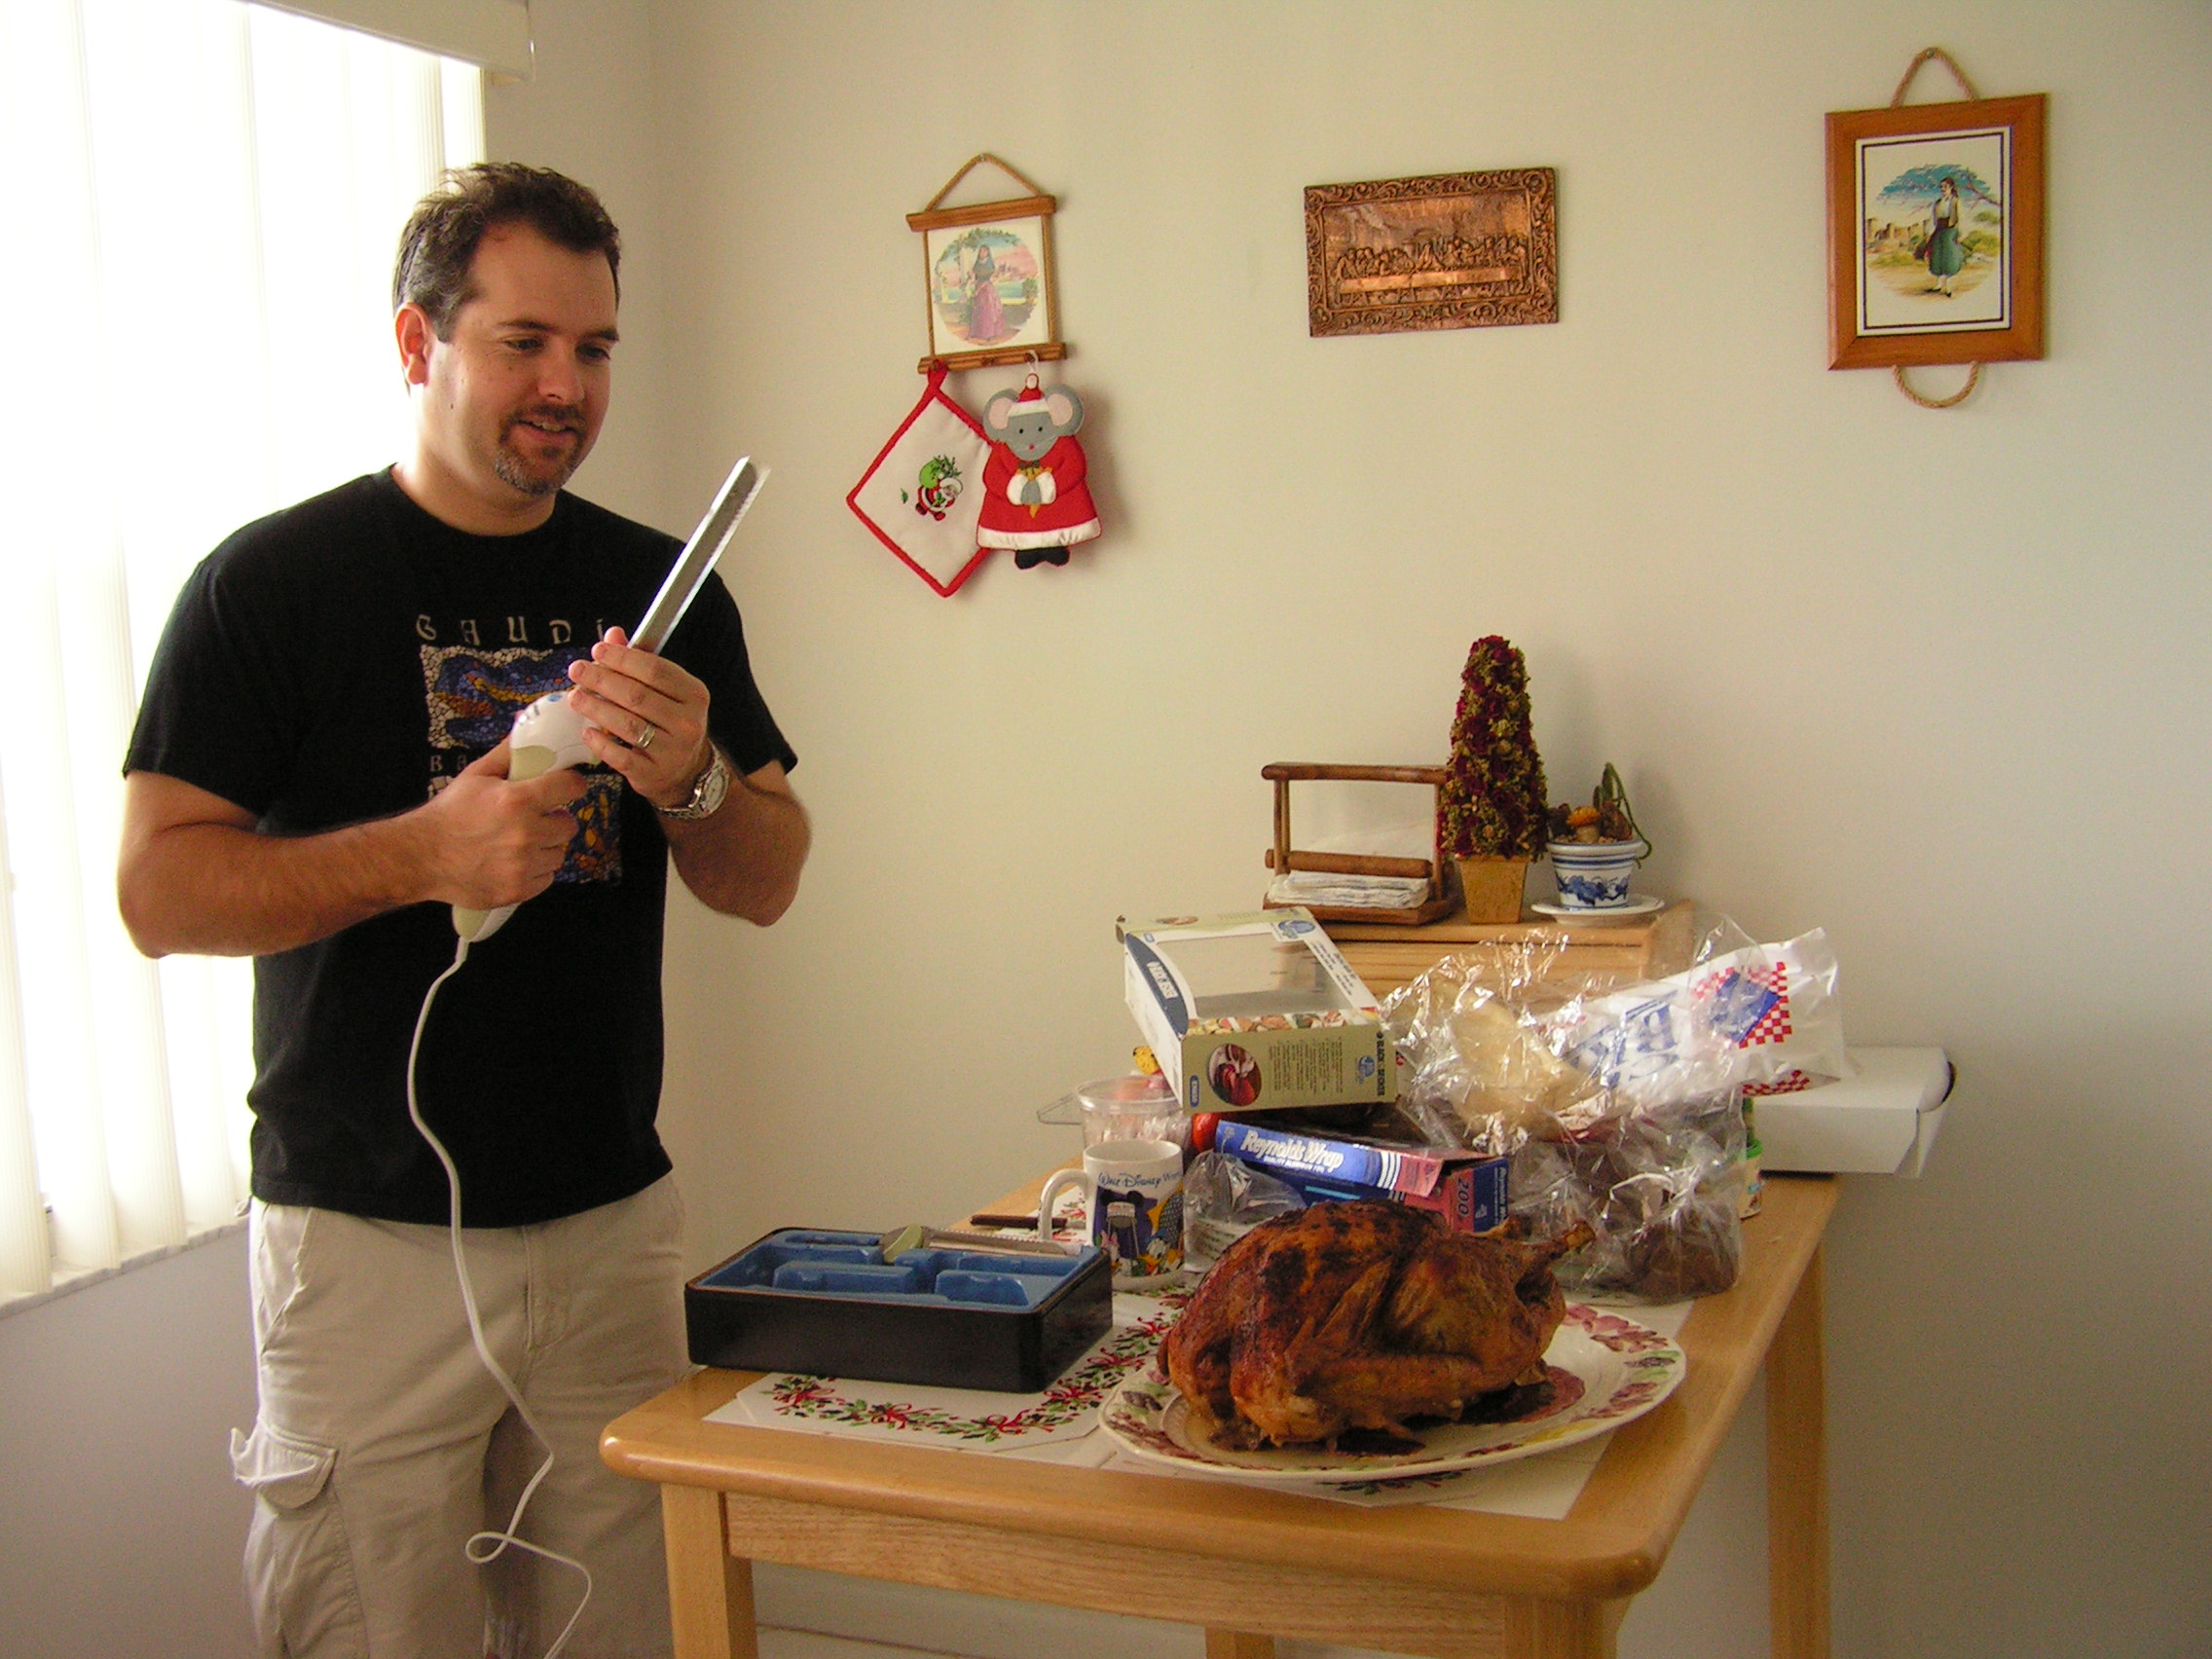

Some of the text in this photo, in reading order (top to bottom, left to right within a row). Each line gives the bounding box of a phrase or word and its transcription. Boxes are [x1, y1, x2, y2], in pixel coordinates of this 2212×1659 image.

[1239, 1129, 1345, 1173] Reynolds Wrap
[1457, 1178, 1470, 1216] 200
